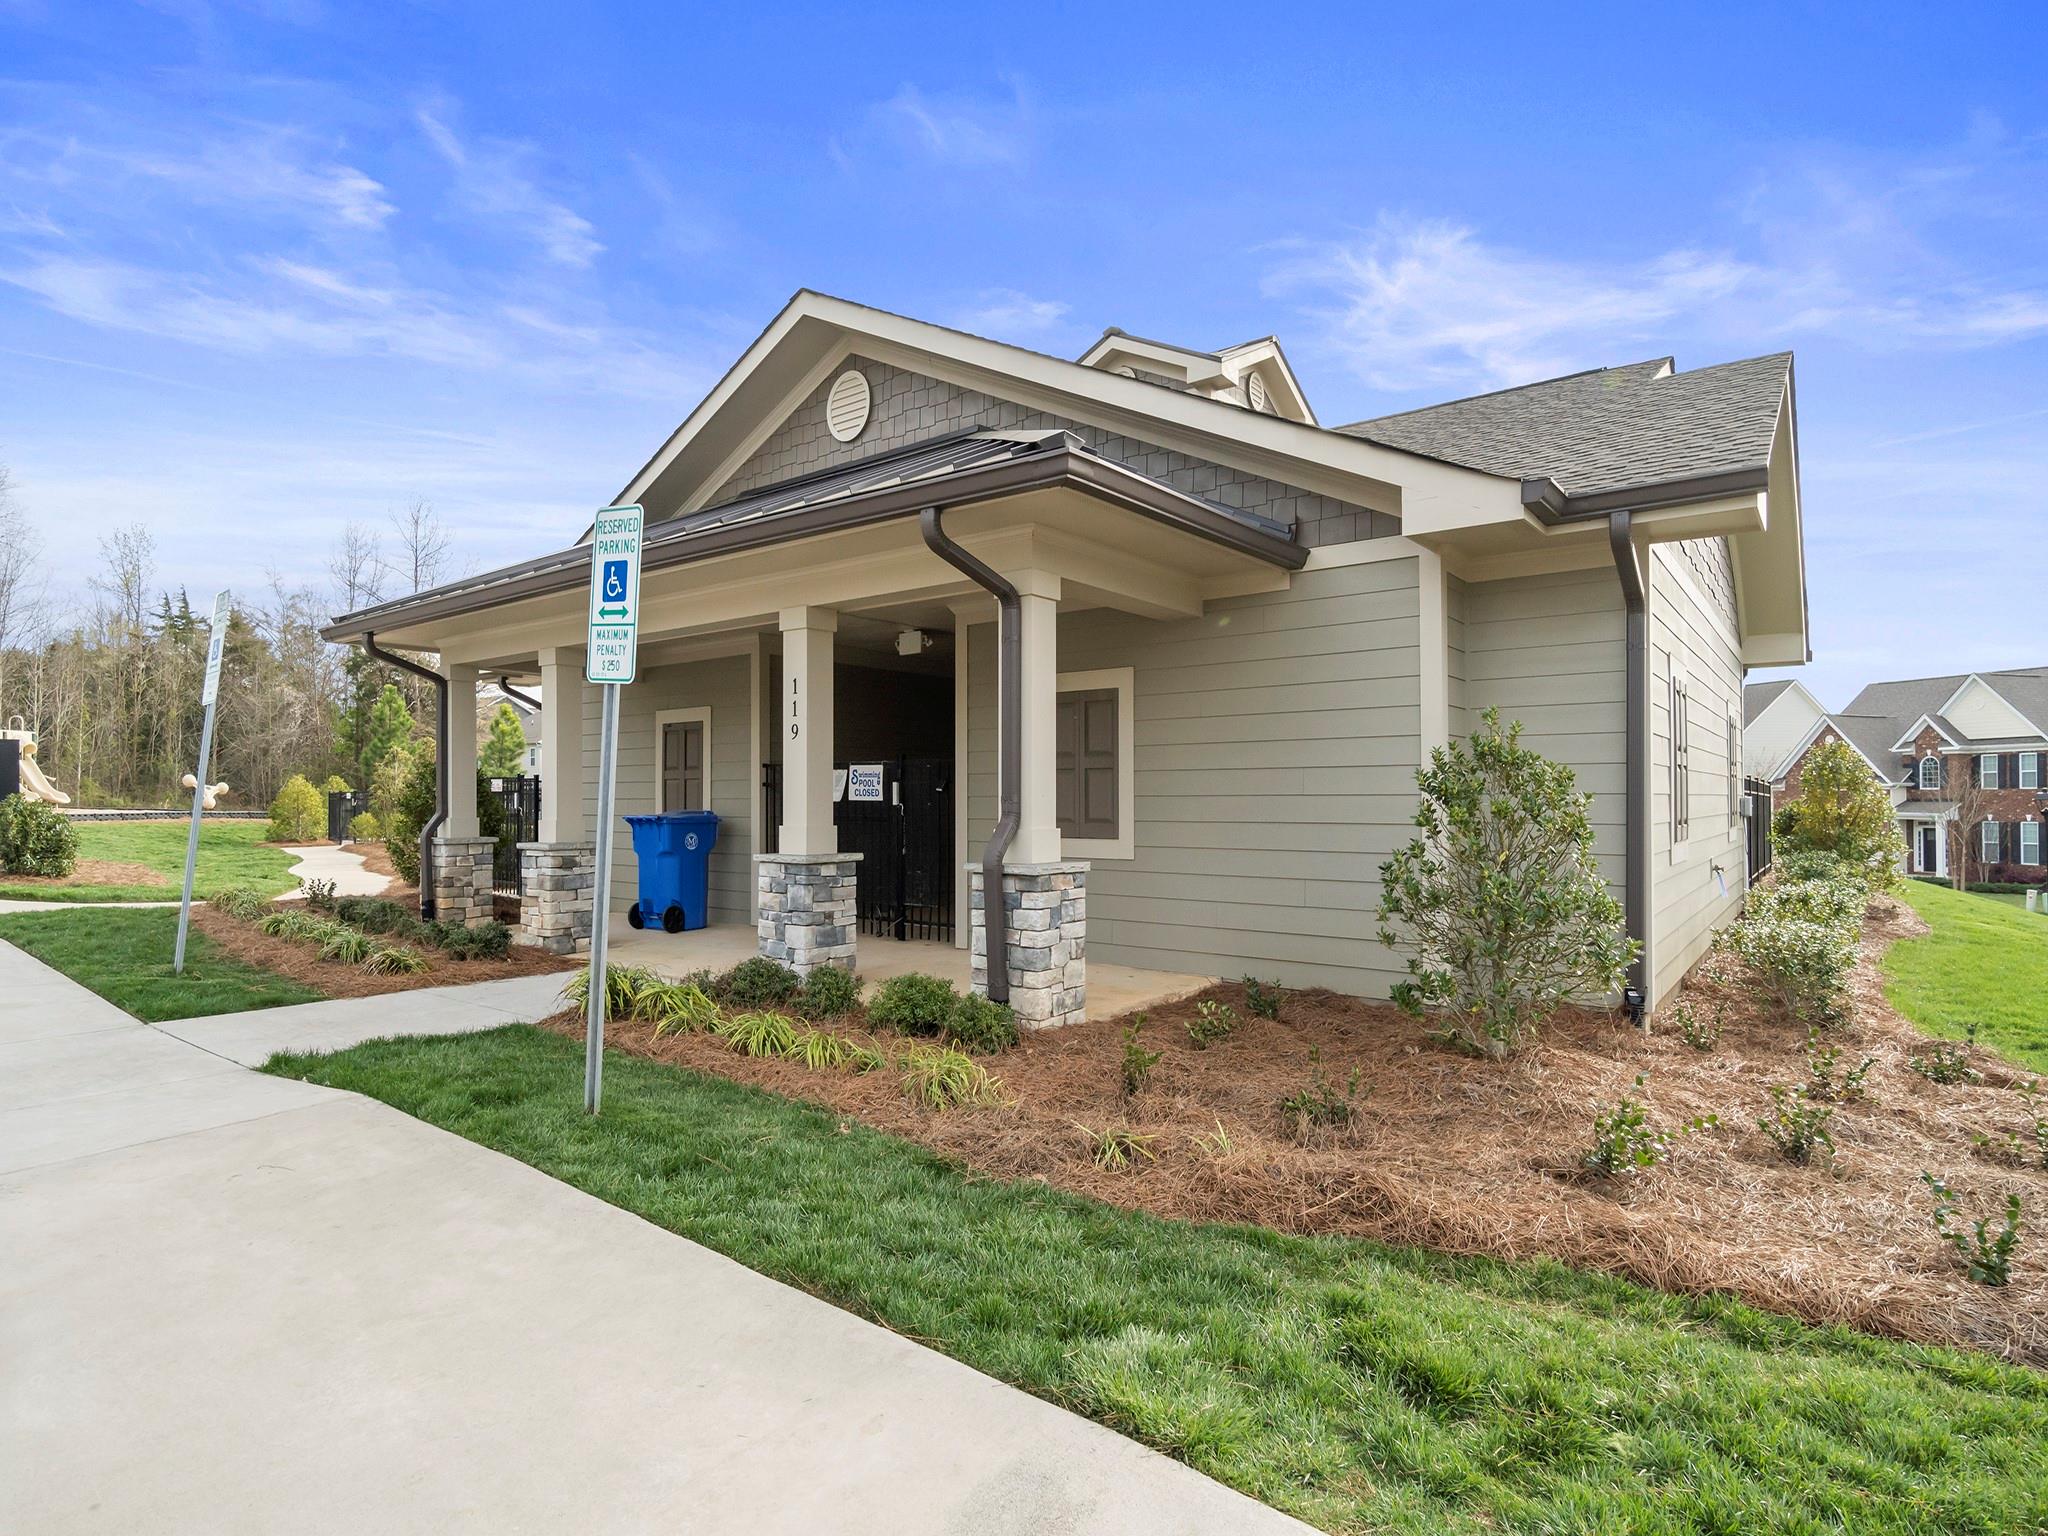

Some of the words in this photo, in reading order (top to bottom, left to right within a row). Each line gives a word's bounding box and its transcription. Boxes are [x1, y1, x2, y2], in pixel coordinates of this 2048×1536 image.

[597, 517, 639, 535] RESERVED
[598, 538, 636, 555] PARKING
[596, 629, 629, 641] MAXIMUM
[596, 644, 627, 656] PENALTY
[858, 780, 875, 788] POOL
[854, 788, 880, 797] CLOSED
